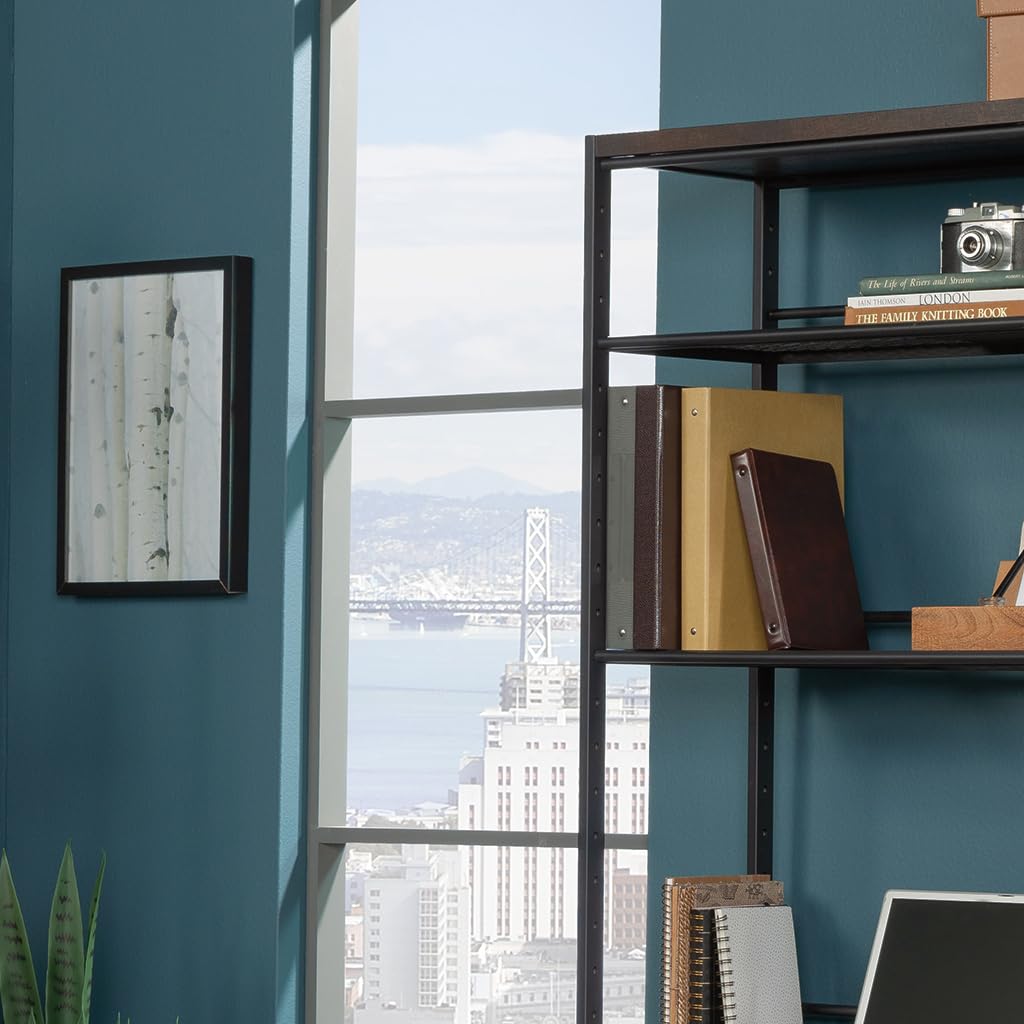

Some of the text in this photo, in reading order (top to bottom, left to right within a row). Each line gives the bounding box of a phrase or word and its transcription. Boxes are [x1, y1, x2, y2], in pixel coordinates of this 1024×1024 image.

[868, 276, 975, 290] The Life of Rivers and Streams
[873, 298, 906, 306] THOMSON
[920, 292, 971, 305] LONDON
[856, 307, 1008, 324] THE FAMILY KNITTING BOOK
